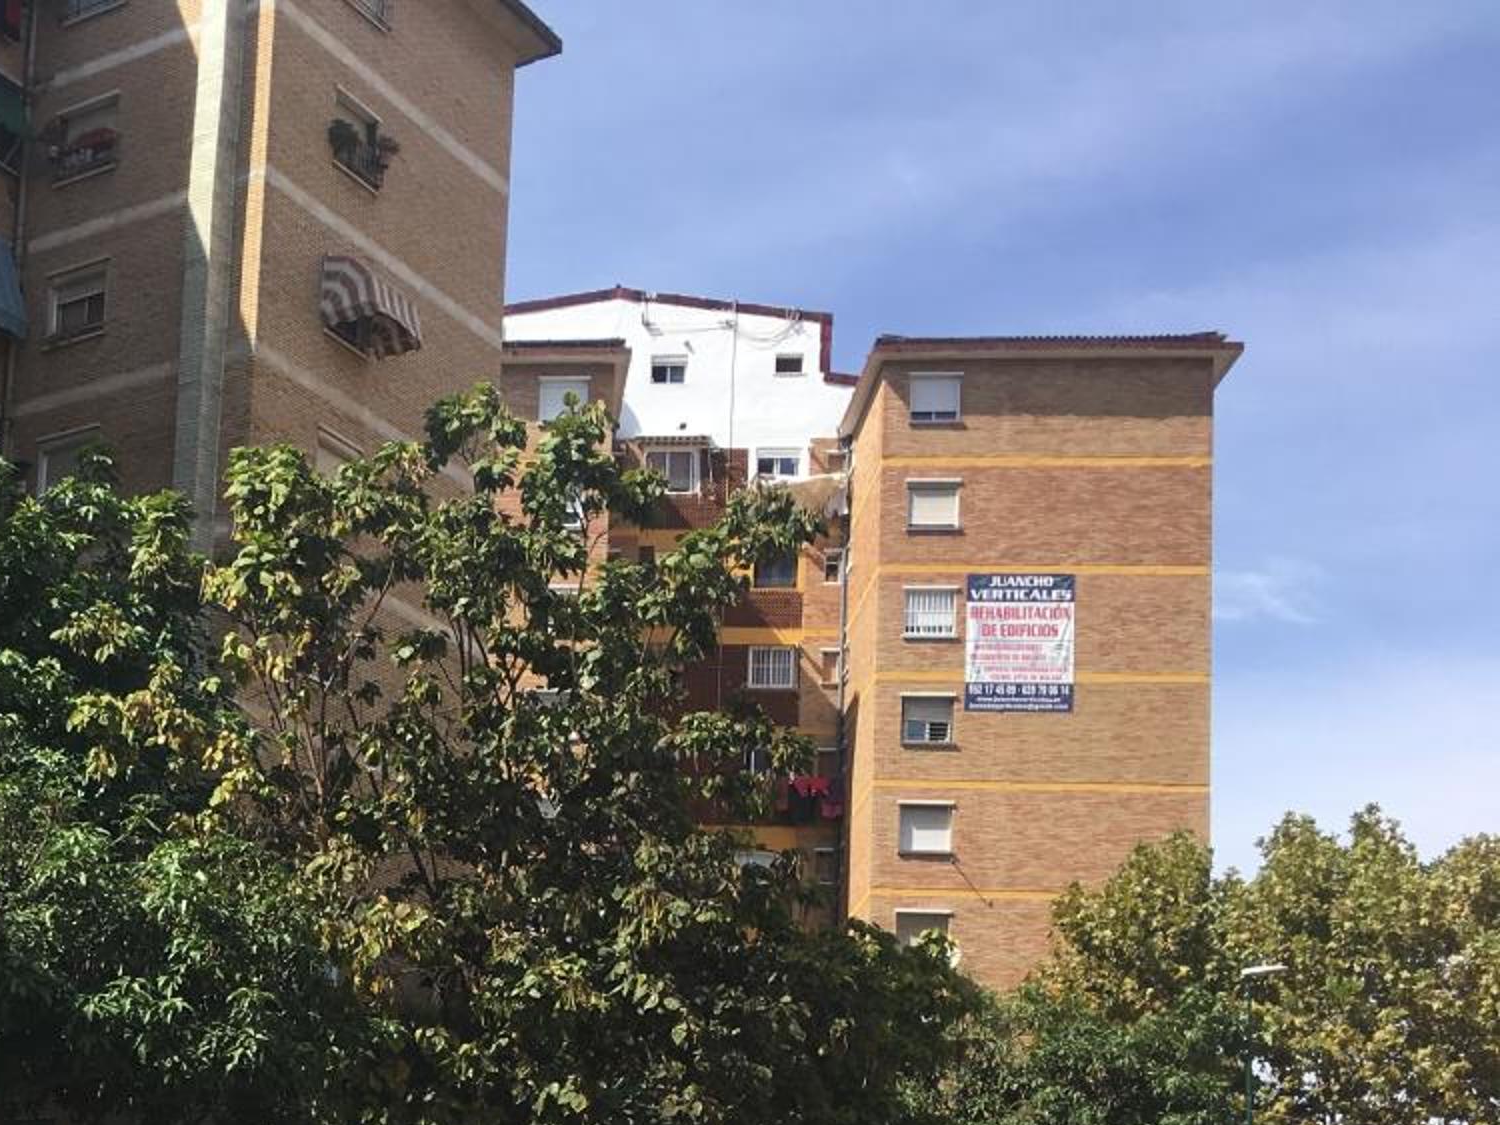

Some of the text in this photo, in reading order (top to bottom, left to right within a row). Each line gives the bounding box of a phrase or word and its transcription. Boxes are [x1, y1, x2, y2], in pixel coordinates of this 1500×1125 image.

[989, 575, 1054, 587] JUANCHO
[970, 588, 1072, 600] VERTICALES
[981, 624, 1059, 637] DE EDIFICIOS
